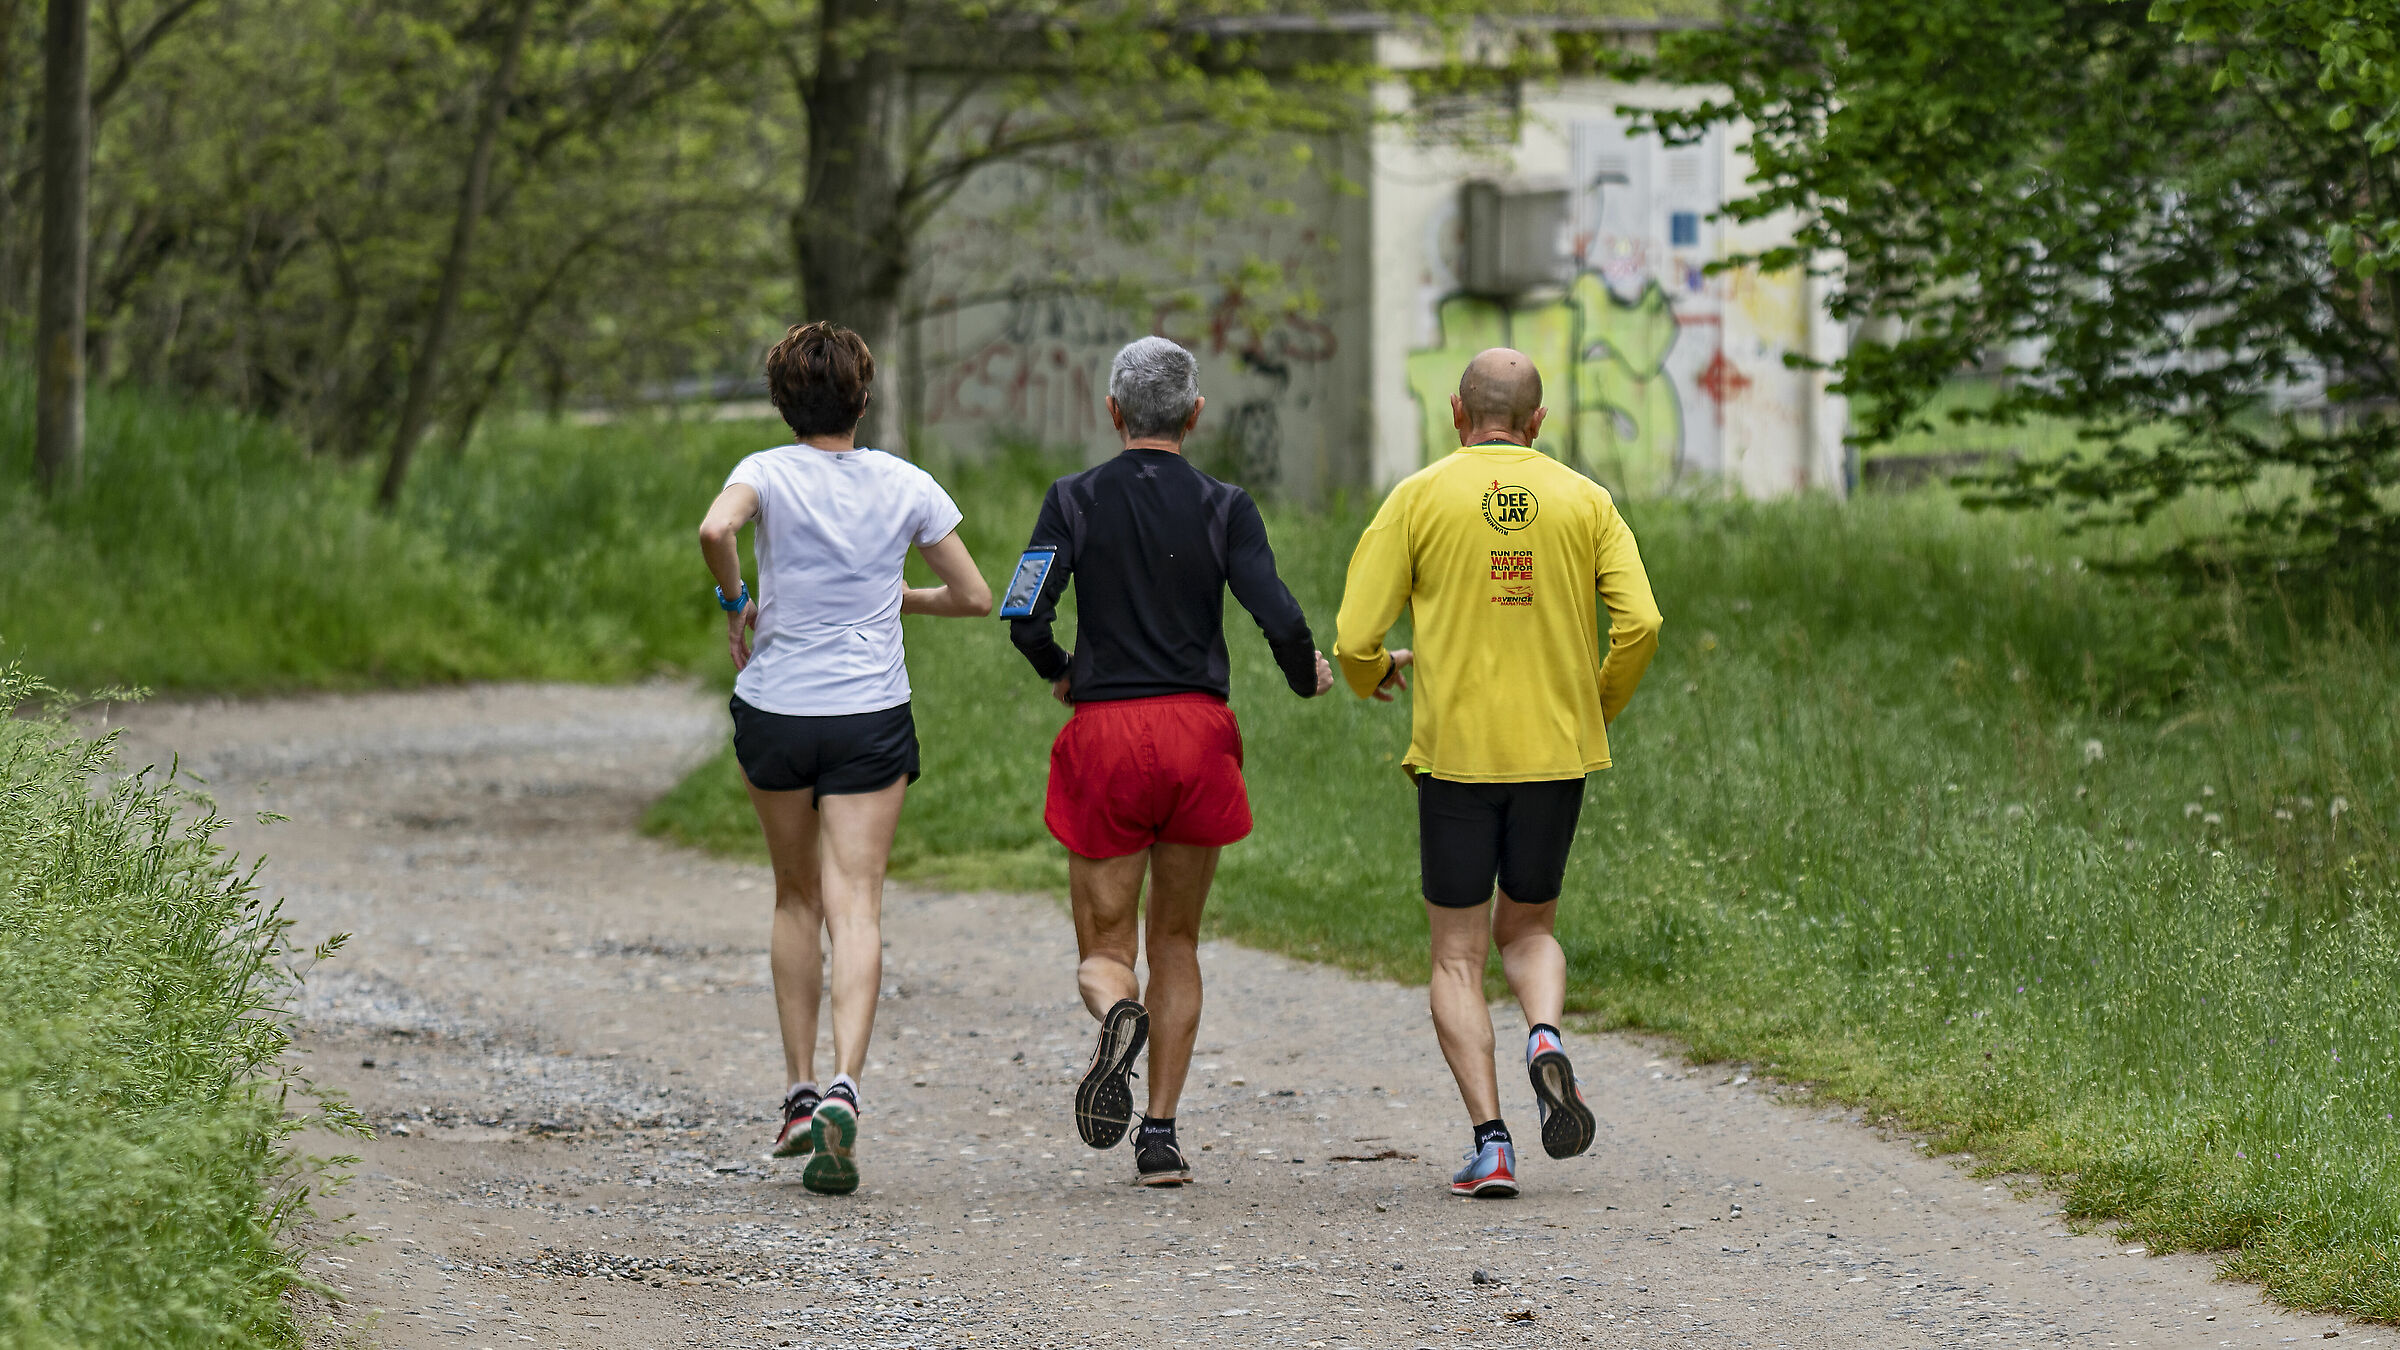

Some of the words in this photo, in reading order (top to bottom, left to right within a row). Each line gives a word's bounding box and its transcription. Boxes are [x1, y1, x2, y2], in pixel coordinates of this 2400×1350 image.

[1481, 492, 1490, 511] TEAM
[1497, 493, 1528, 507] DEE
[1490, 556, 1533, 566] WATER
[1490, 571, 1533, 580] LIFE
